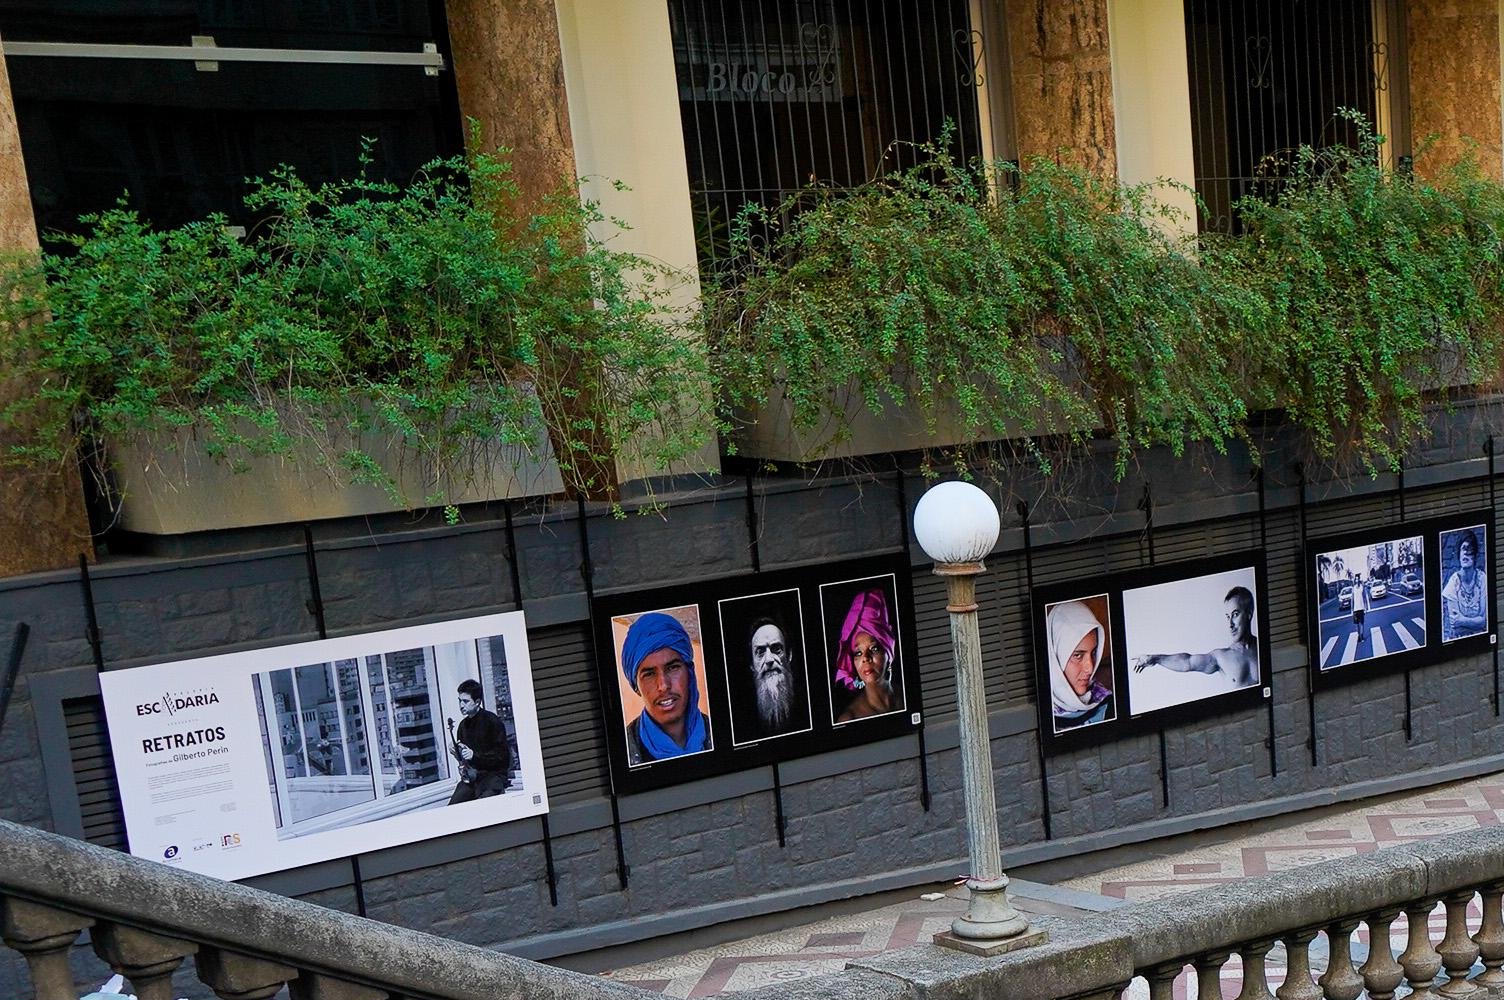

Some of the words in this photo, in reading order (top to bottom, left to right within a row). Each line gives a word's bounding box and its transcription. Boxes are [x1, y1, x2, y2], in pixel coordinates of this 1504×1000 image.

[706, 63, 796, 95] Bloco
[142, 726, 226, 753] RETRATOS
[173, 749, 206, 762] Gilberto
[207, 746, 229, 757] Perin
